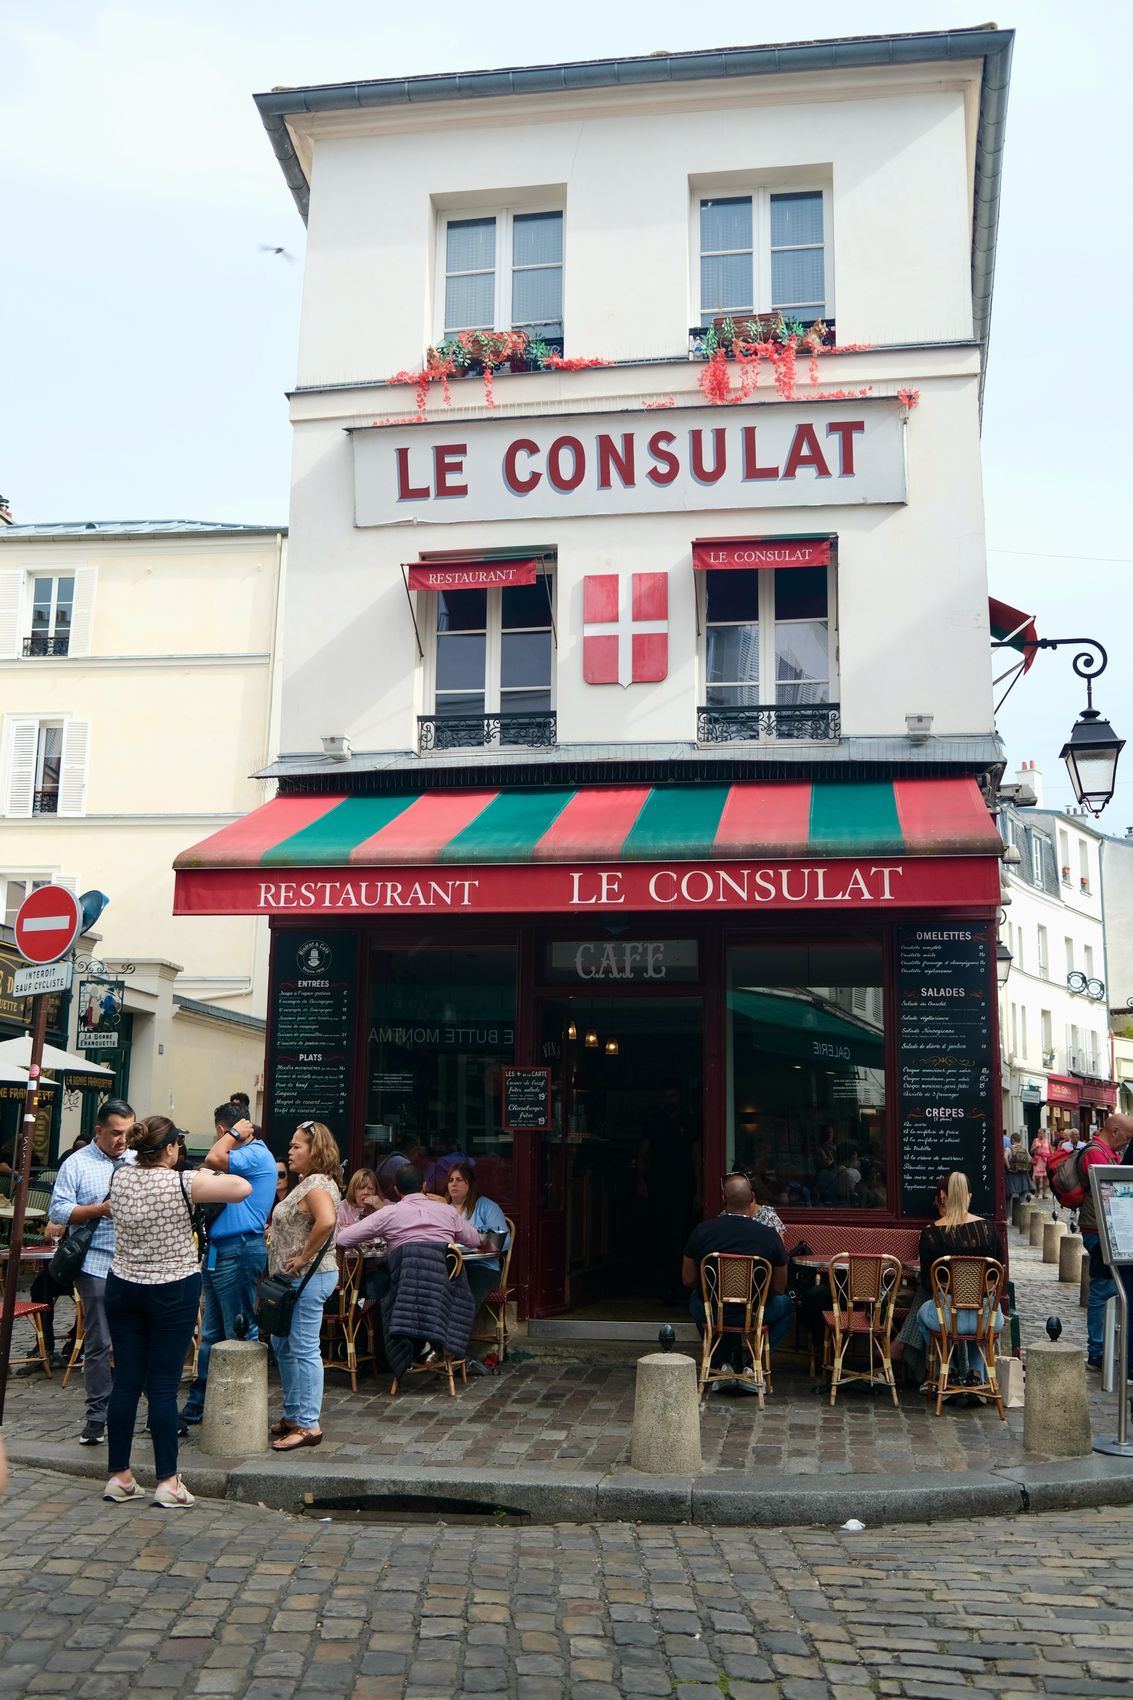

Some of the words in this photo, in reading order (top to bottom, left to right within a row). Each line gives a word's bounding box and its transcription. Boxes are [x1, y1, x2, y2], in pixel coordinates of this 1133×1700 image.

[396, 443, 468, 502] LE
[503, 420, 865, 496] CONSULAT
[710, 552, 727, 564] LE
[734, 549, 812, 563] CONSULAT
[428, 569, 516, 585] RESTAURANT
[569, 872, 625, 904] LE
[649, 866, 903, 902] CONSULAT
[257, 880, 479, 907] RESTAURANT
[916, 931, 971, 940] OMELETTES
[26, 968, 55, 980] INTERDIT
[16, 983, 32, 992] SAUF
[35, 978, 64, 990] CYCLISTE
[921, 988, 965, 997] SALADES
[926, 1107, 964, 1117] CRÊPES
